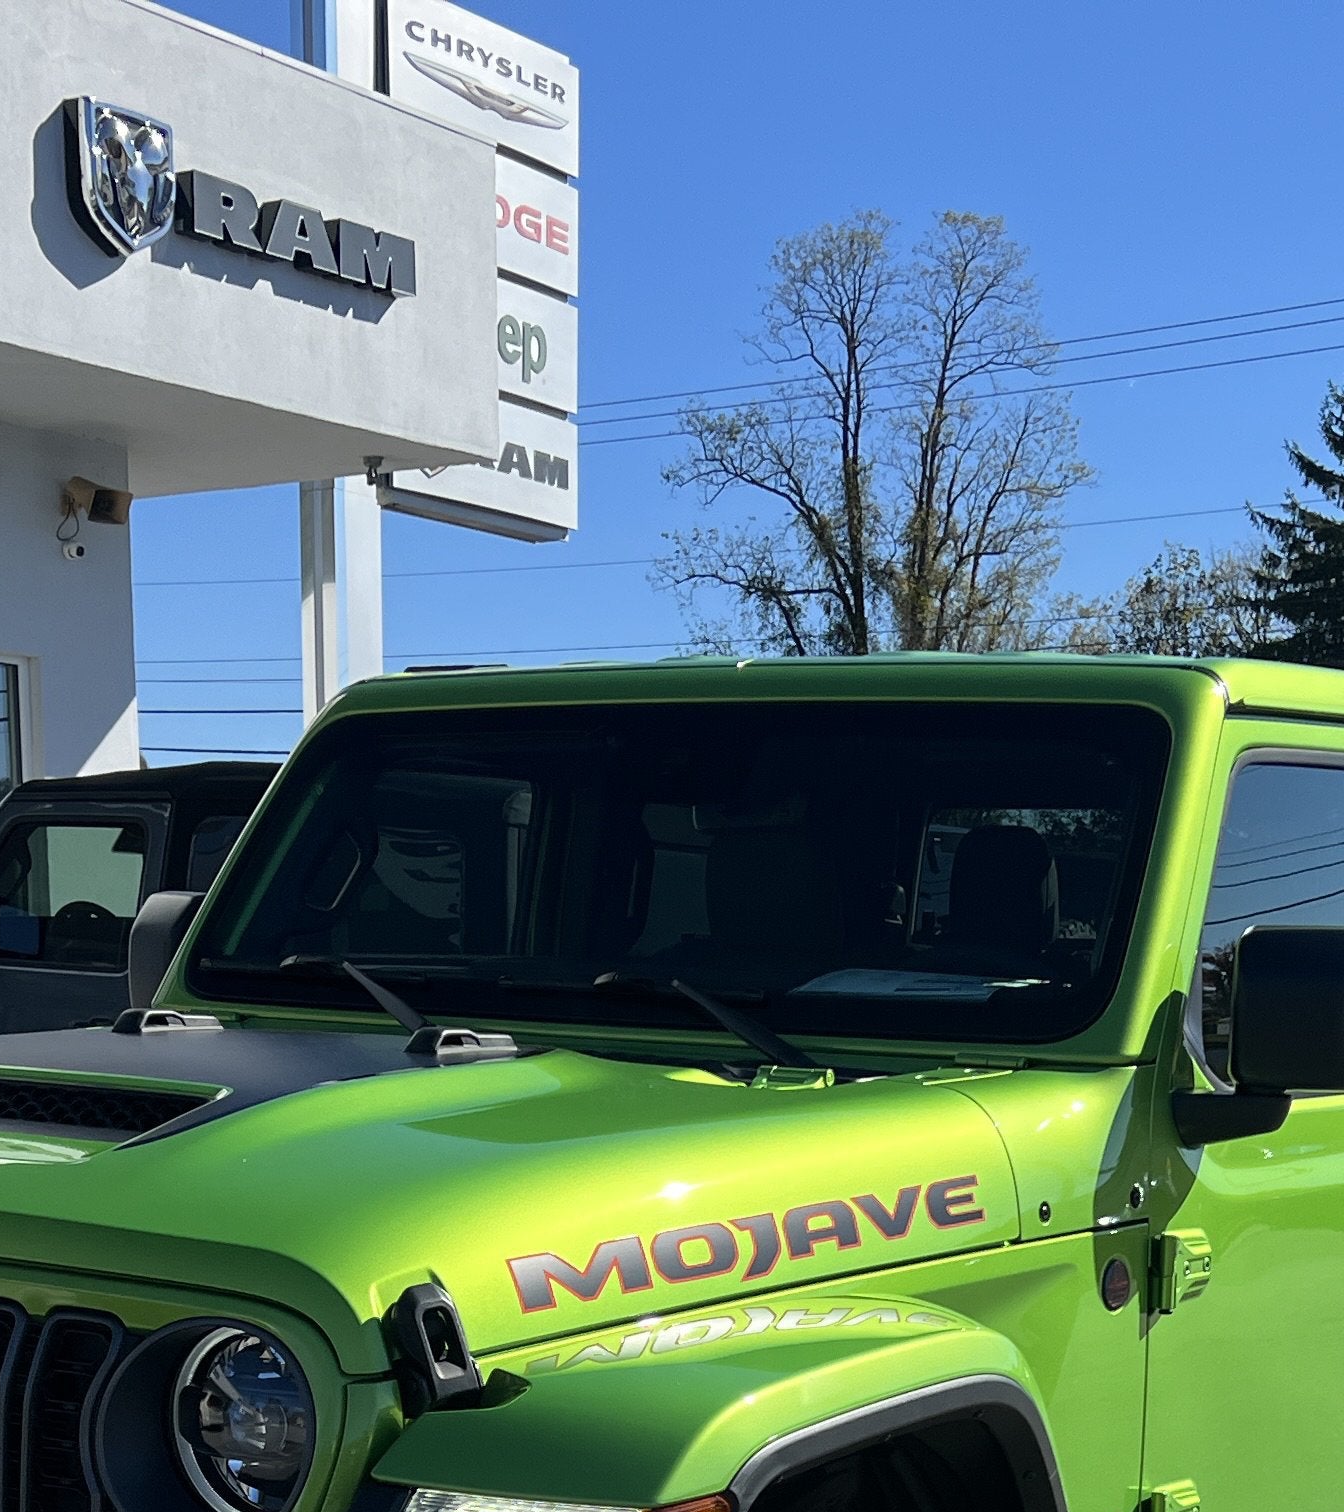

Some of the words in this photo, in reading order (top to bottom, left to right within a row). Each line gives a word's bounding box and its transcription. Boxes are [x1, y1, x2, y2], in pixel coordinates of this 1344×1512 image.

[405, 20, 566, 103] CHRYSLER
[177, 168, 416, 297] RAM
[497, 314, 547, 384] ep
[479, 441, 569, 491] AM
[505, 1174, 986, 1313] MOJAVE
